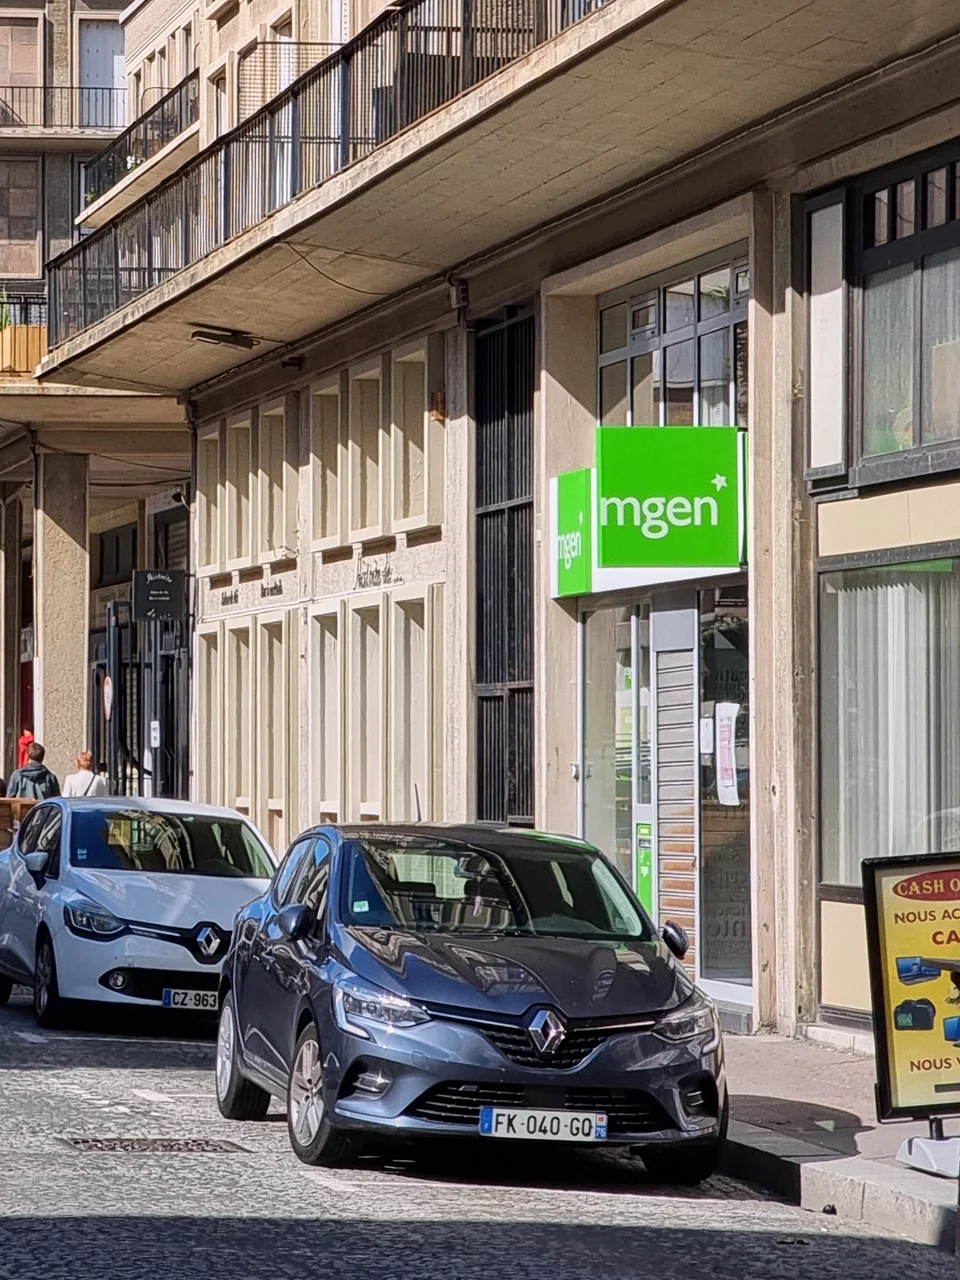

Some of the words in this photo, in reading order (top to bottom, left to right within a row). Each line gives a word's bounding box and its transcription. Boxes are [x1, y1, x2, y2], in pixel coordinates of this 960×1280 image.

[600, 496, 719, 539] mgen
[557, 531, 581, 570] mgen
[897, 879, 945, 896] CASH
[894, 910, 937, 924] NOUS
[910, 1057, 952, 1072] NOUS
[595, 1127, 607, 1138] 76
